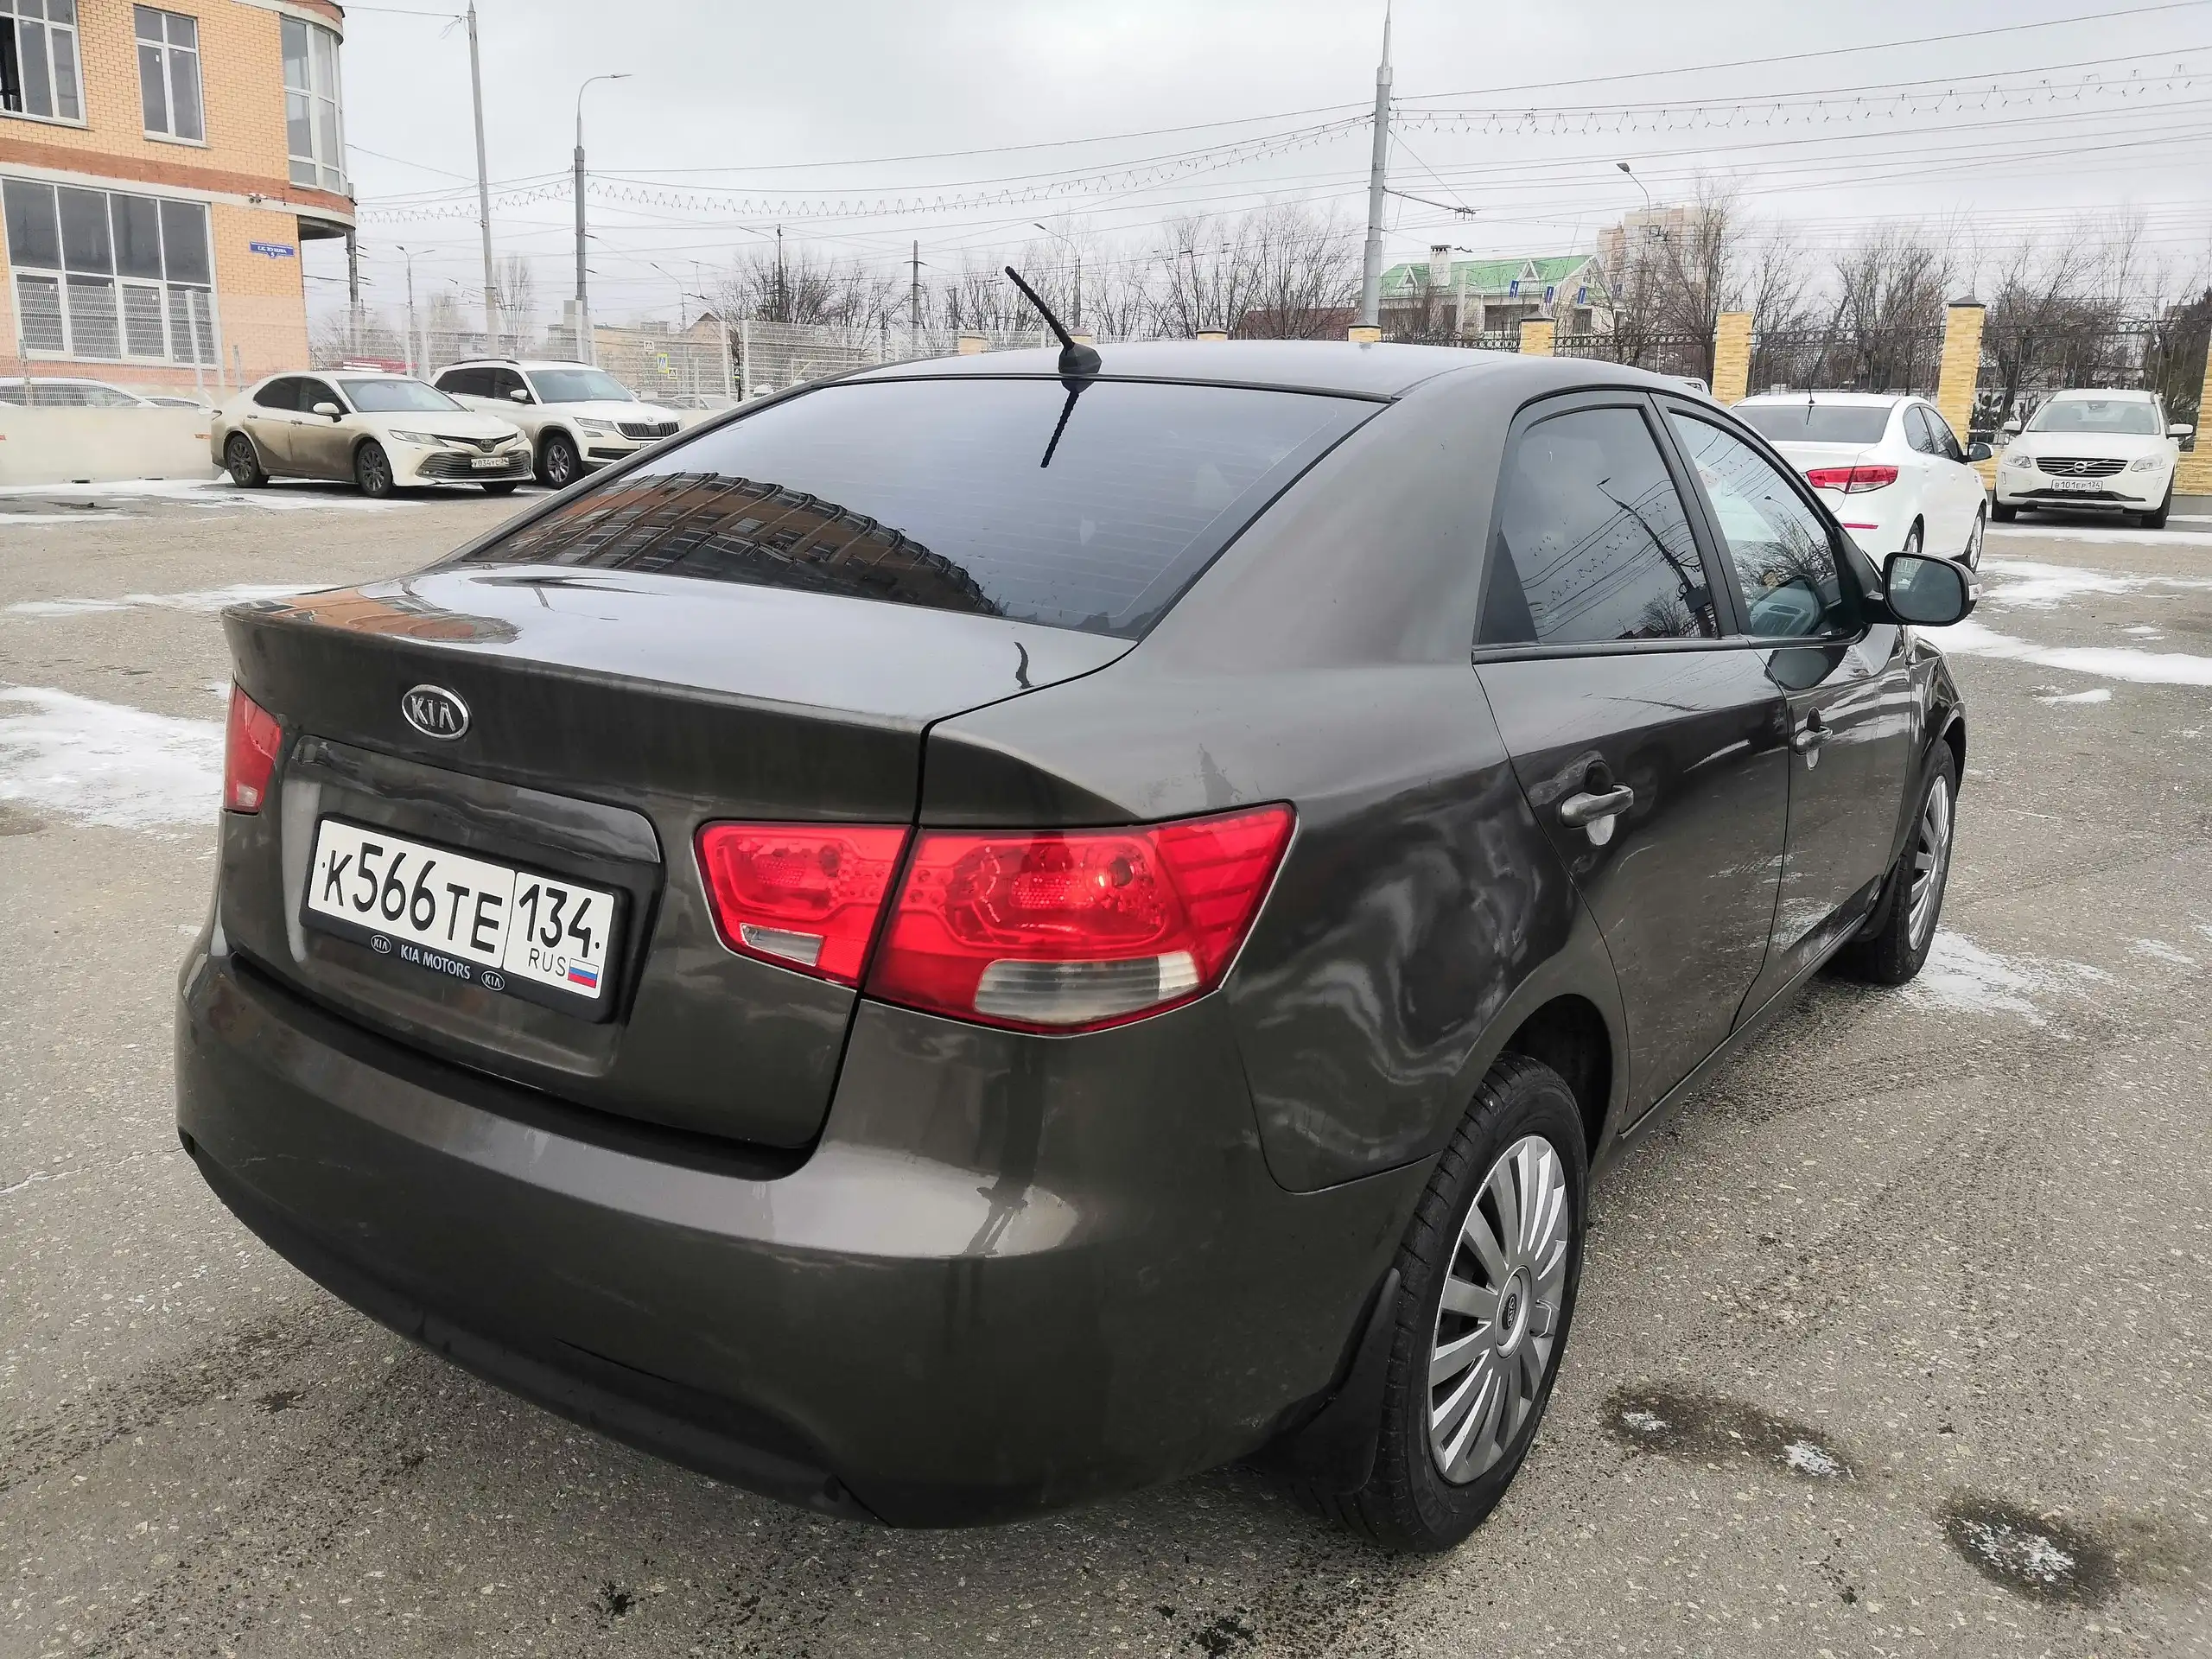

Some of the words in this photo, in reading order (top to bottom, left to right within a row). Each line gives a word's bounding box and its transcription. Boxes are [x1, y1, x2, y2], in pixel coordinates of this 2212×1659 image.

[409, 693, 457, 733] KIA
[519, 883, 593, 958] 134
[372, 937, 389, 951] KIA
[400, 944, 420, 964] KIA
[423, 951, 471, 980] MOTORS
[528, 947, 566, 977] RUS
[484, 973, 502, 988] KIA
